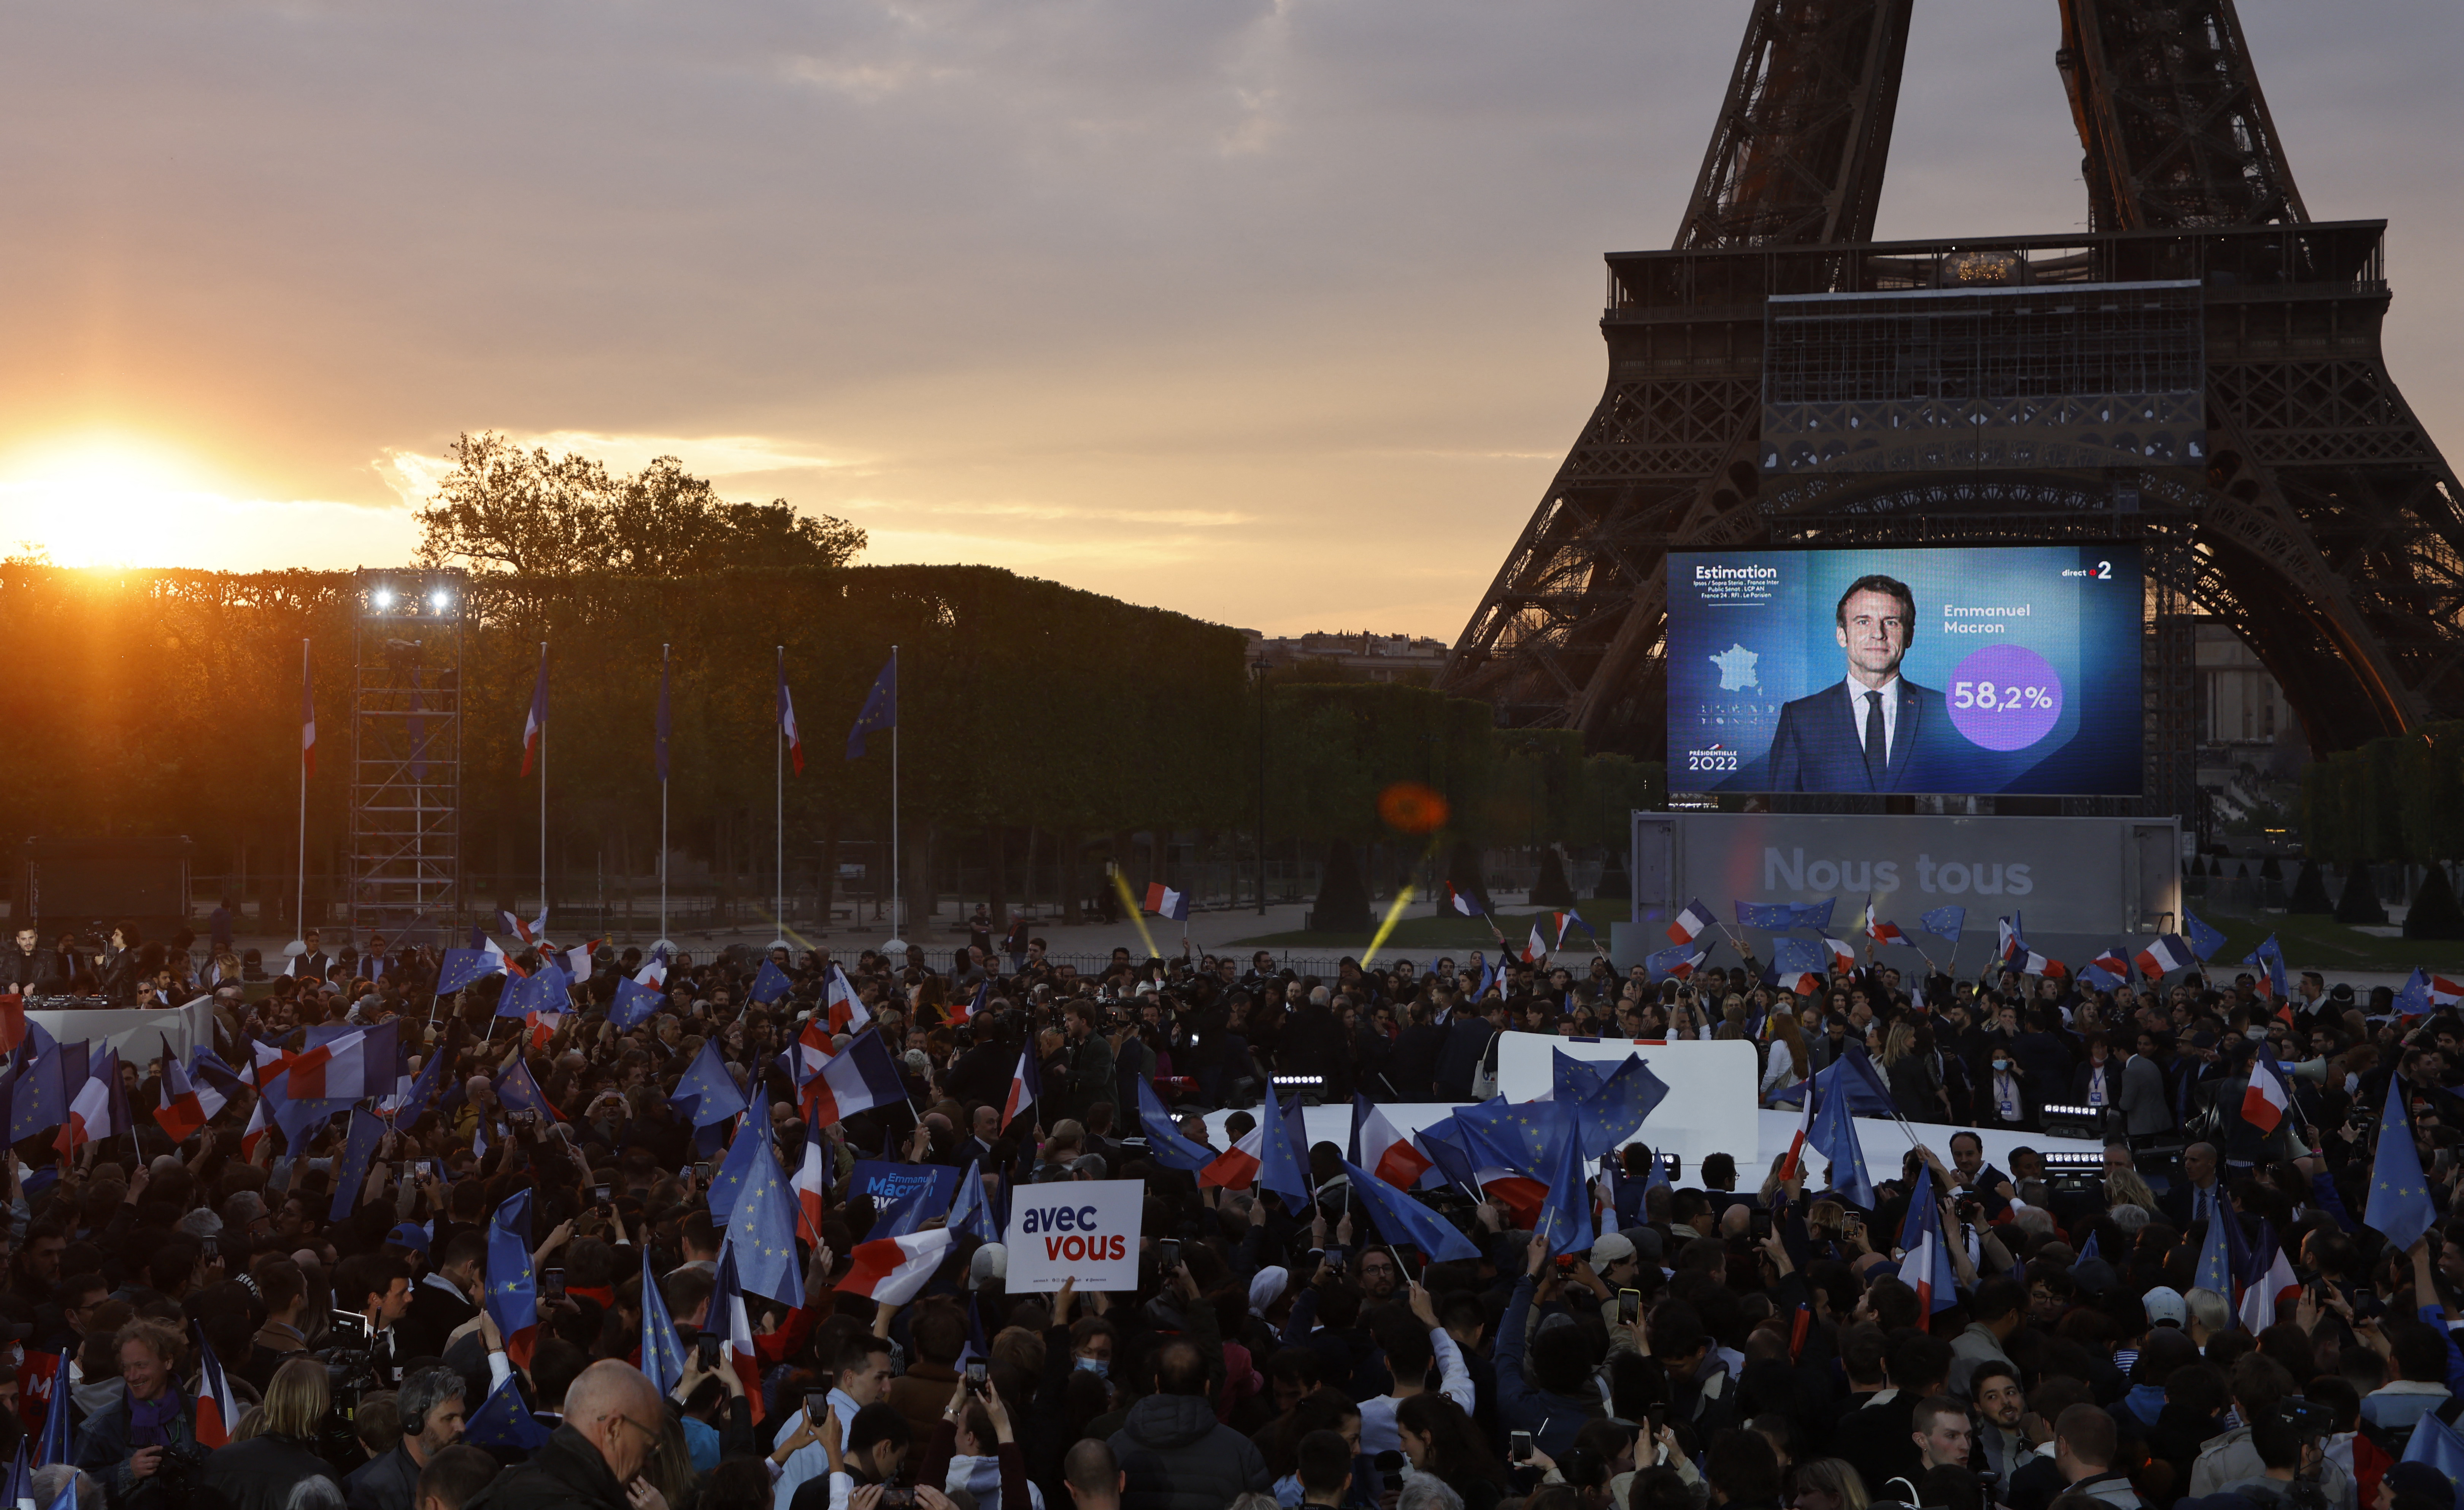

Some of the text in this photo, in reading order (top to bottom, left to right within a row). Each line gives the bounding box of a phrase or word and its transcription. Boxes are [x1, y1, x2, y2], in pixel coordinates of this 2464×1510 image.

[1696, 565, 1777, 579] Estimation
[2097, 561, 2112, 579] 2
[1944, 604, 2030, 617] Emmanuel
[1944, 621, 2005, 633] Macron
[1954, 681, 2053, 712] 58,2%
[1689, 756, 1737, 770] 2022
[1764, 847, 2033, 896] Nous tous
[888, 1172, 937, 1183] Emmanul
[1022, 1205, 1097, 1234] avec
[1045, 1234, 1126, 1261] vous
